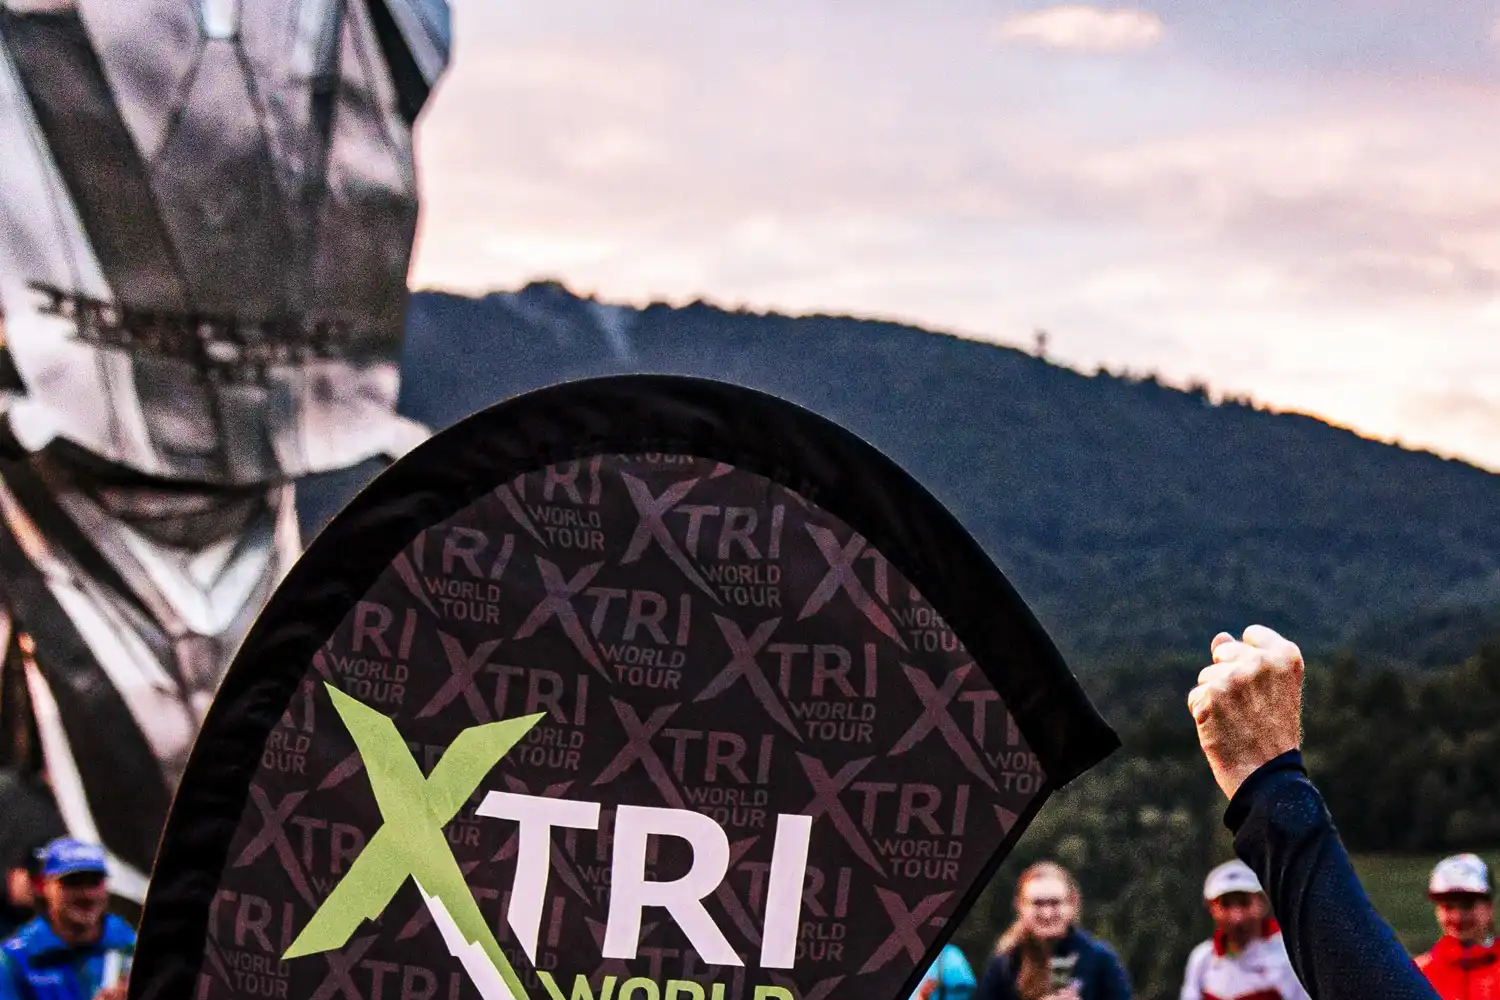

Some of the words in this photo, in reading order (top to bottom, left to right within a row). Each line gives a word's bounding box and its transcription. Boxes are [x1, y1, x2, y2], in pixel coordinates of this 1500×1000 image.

[525, 503, 601, 529] WORLD
[543, 523, 606, 551] TOUR
[619, 471, 786, 606] XTRI
[699, 564, 782, 585] WORLD
[425, 576, 501, 603] WORLD
[719, 584, 782, 609] TOUR
[441, 598, 500, 625] TOUR
[512, 553, 693, 685] XTRI
[329, 653, 410, 683] WORLD
[600, 644, 686, 668] WORLD
[614, 663, 682, 689] TOUR
[693, 612, 878, 743] XTRI
[344, 676, 407, 704] TOUR
[792, 702, 876, 721] WORLD
[267, 730, 313, 752] RLD
[527, 727, 585, 749] ORLD
[806, 720, 873, 744] TOUR
[261, 751, 307, 774] OUR
[518, 744, 581, 771] TOUR
[590, 695, 775, 808] XTRI
[683, 786, 769, 808] WORLD
[795, 751, 972, 880] XTRI
[232, 780, 365, 910] XTR
[872, 837, 964, 859] WORLD
[888, 858, 960, 882] TOUR
[222, 949, 291, 978] WORLD
[794, 940, 845, 963] OUR
[234, 973, 288, 999] TOUR
